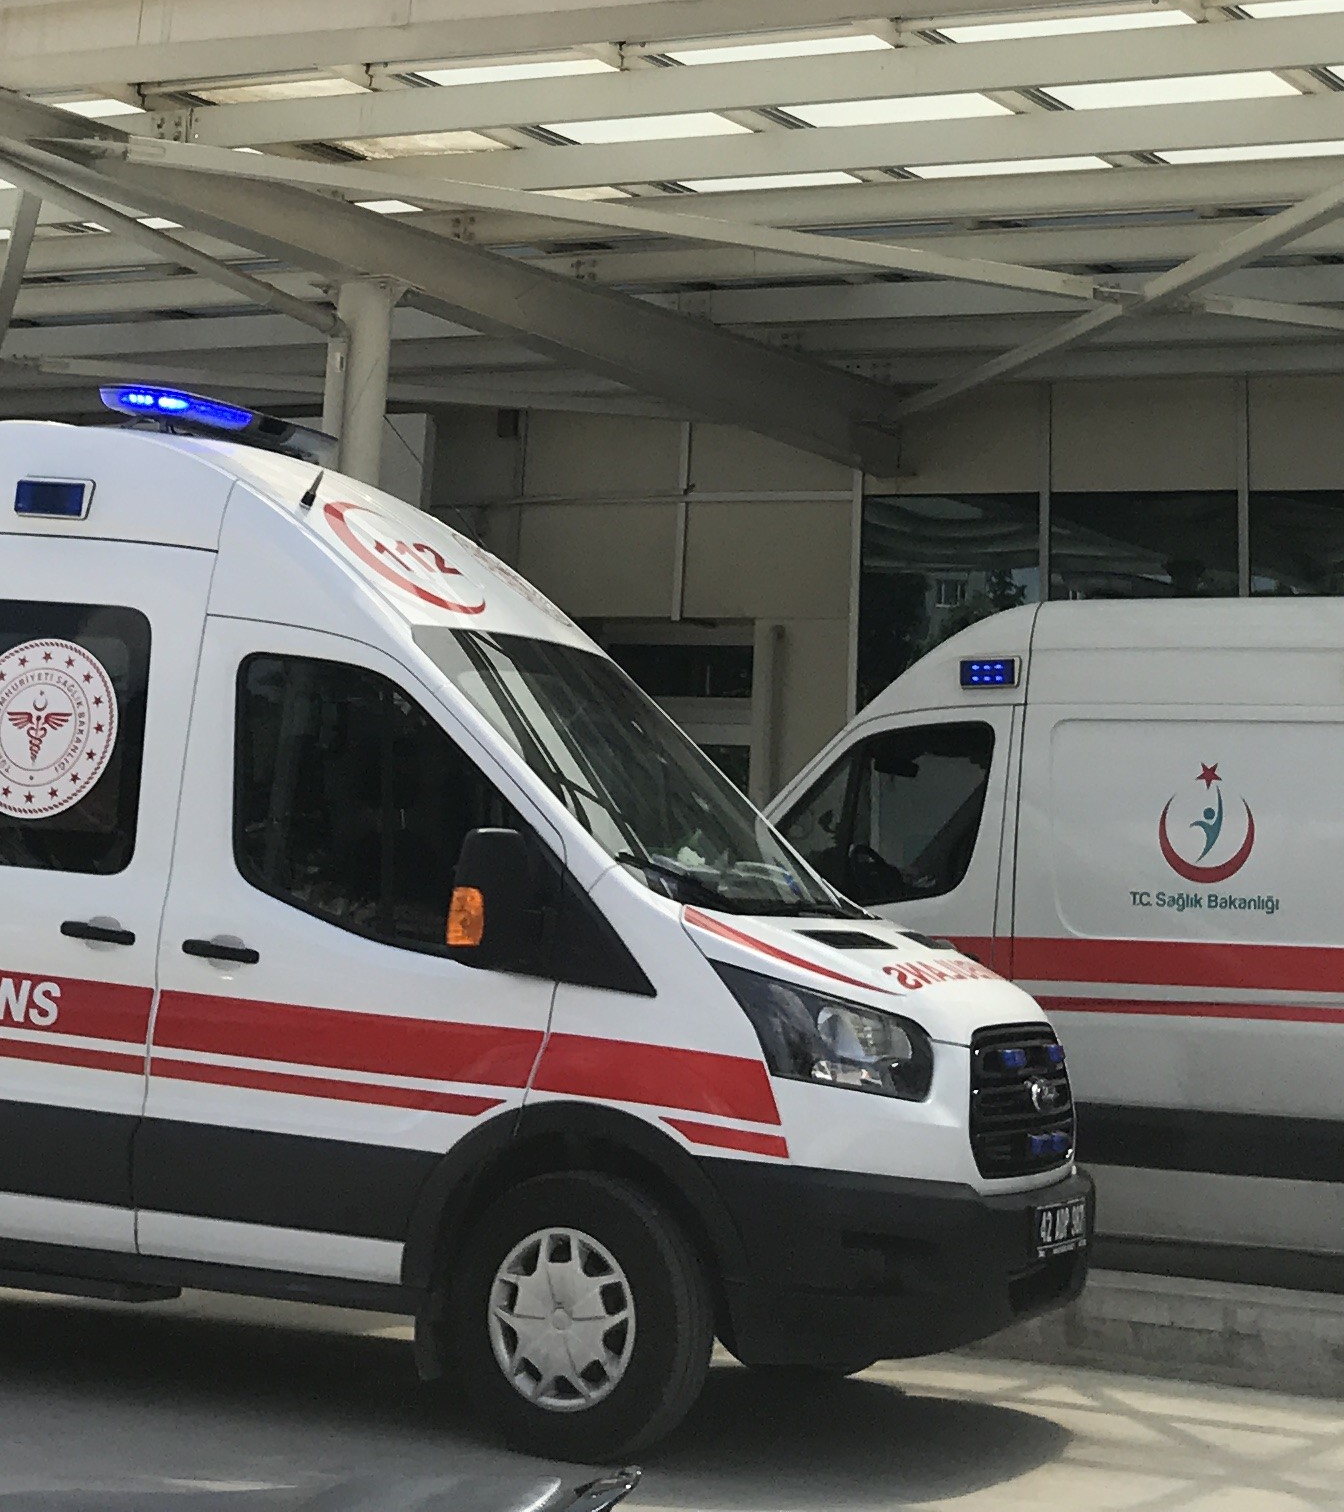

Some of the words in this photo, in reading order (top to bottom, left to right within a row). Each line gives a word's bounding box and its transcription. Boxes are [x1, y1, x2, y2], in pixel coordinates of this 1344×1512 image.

[372, 538, 464, 576] 112
[1155, 891, 1203, 913] Sağlık
[1207, 893, 1280, 915] Bakanlığı
